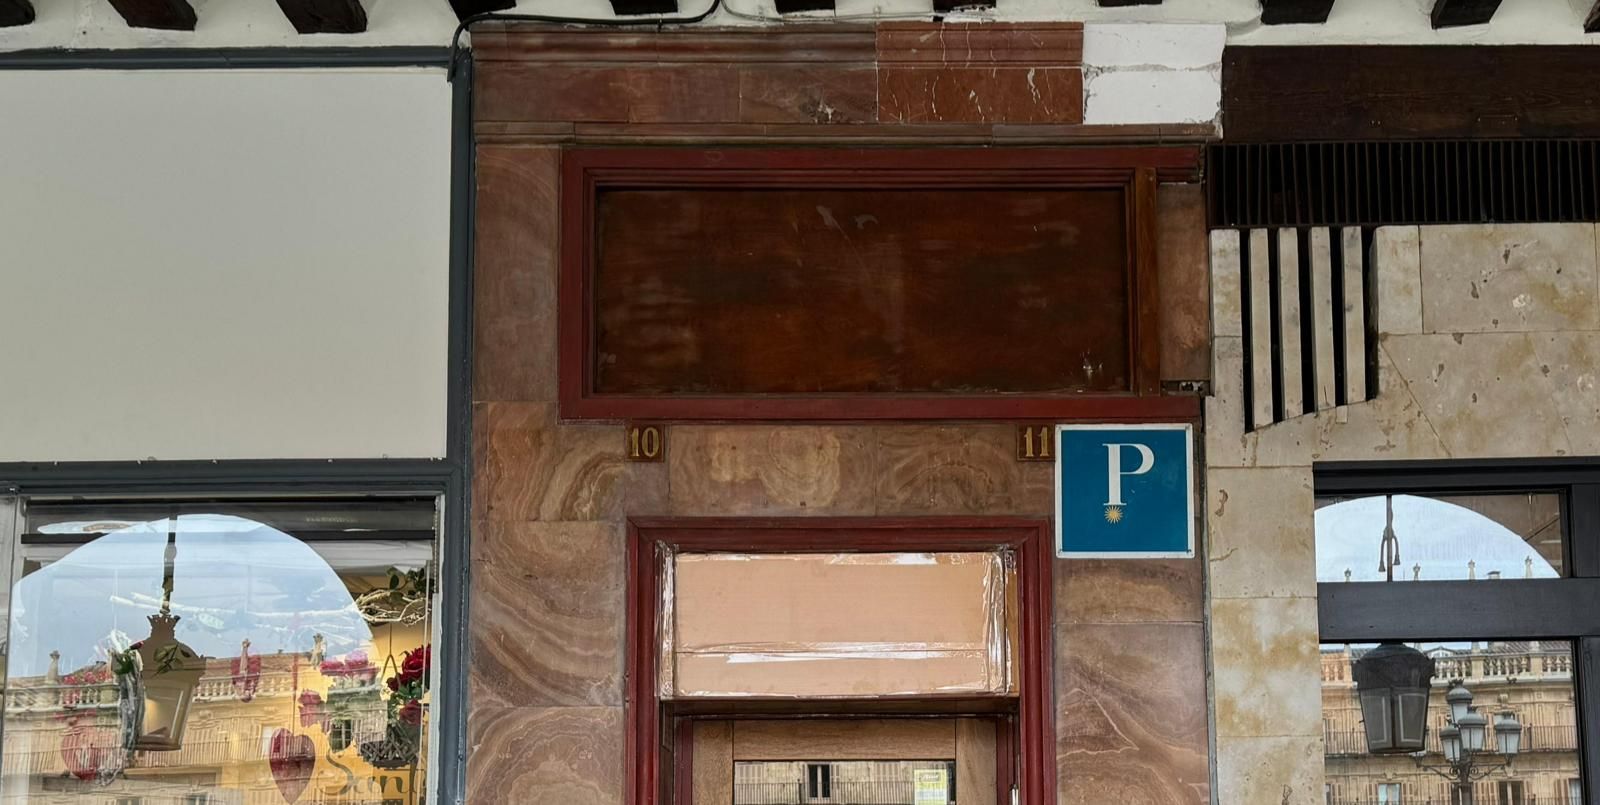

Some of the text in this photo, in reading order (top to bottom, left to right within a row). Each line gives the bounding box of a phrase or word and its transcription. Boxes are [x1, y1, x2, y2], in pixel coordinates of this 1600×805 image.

[631, 427, 660, 457] 10
[1023, 426, 1050, 457] 11
[1102, 443, 1155, 506] P
